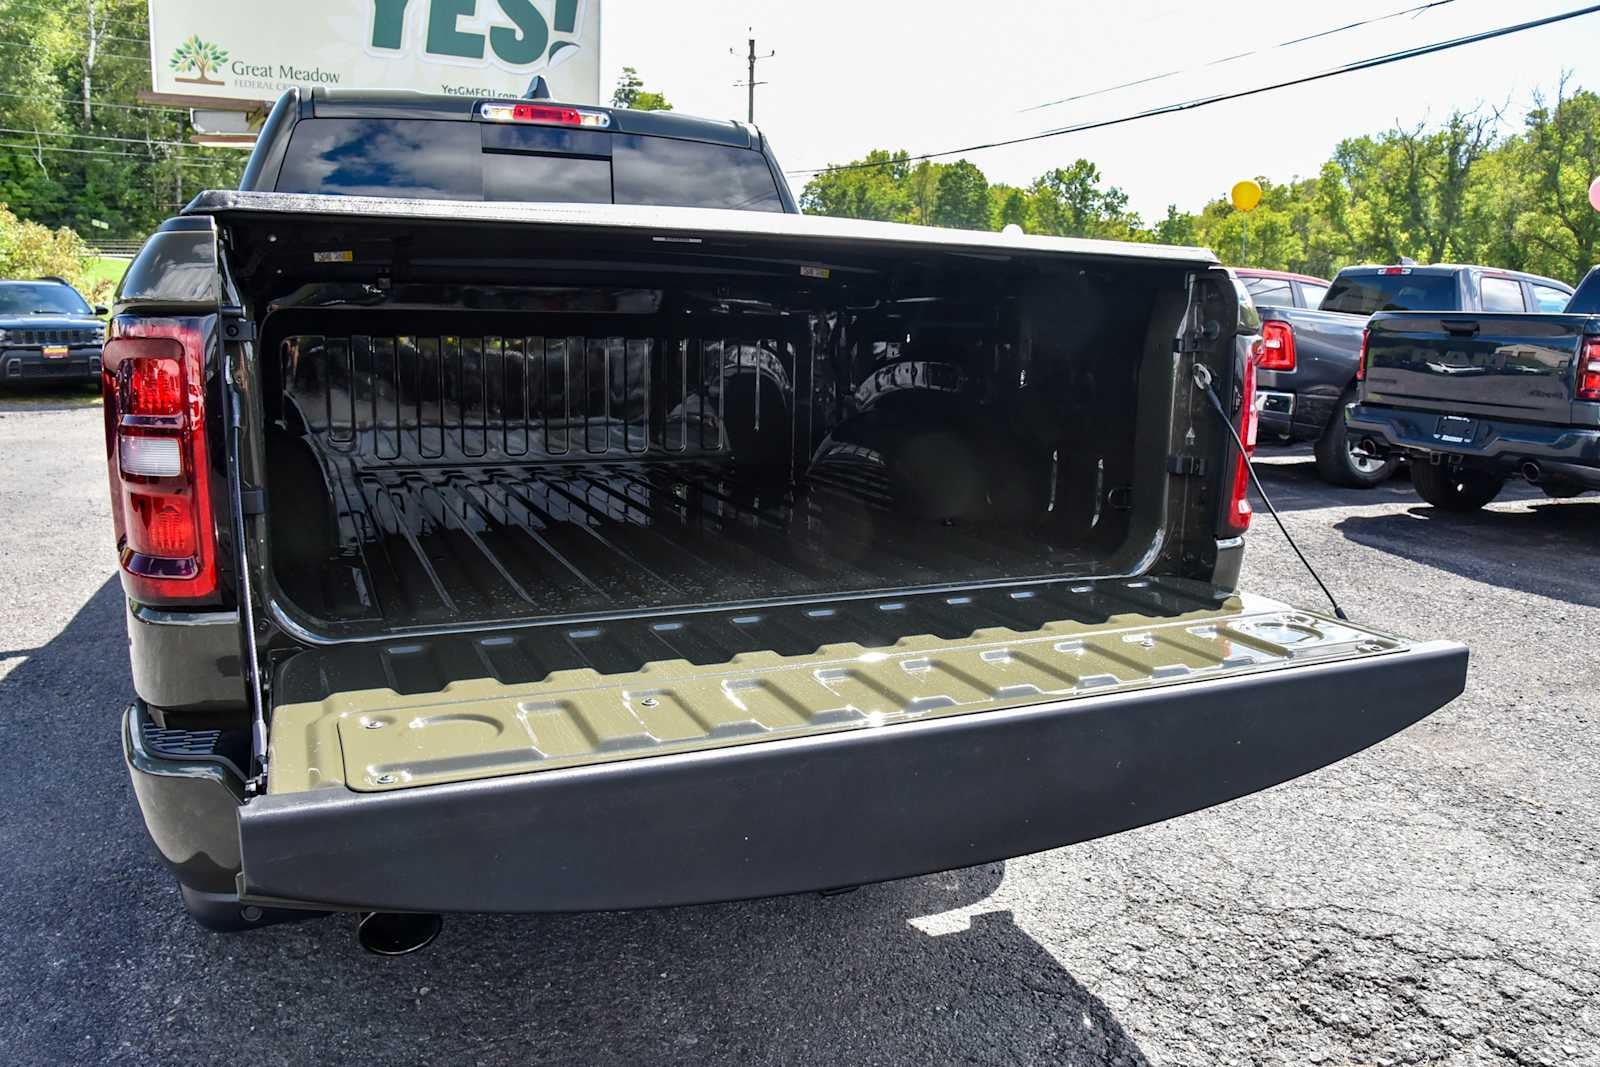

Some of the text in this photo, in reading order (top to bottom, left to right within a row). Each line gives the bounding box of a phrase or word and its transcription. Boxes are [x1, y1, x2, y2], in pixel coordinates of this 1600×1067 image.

[231, 60, 341, 84] Great Meadow
[441, 84, 518, 99] YesGMFCUcom
